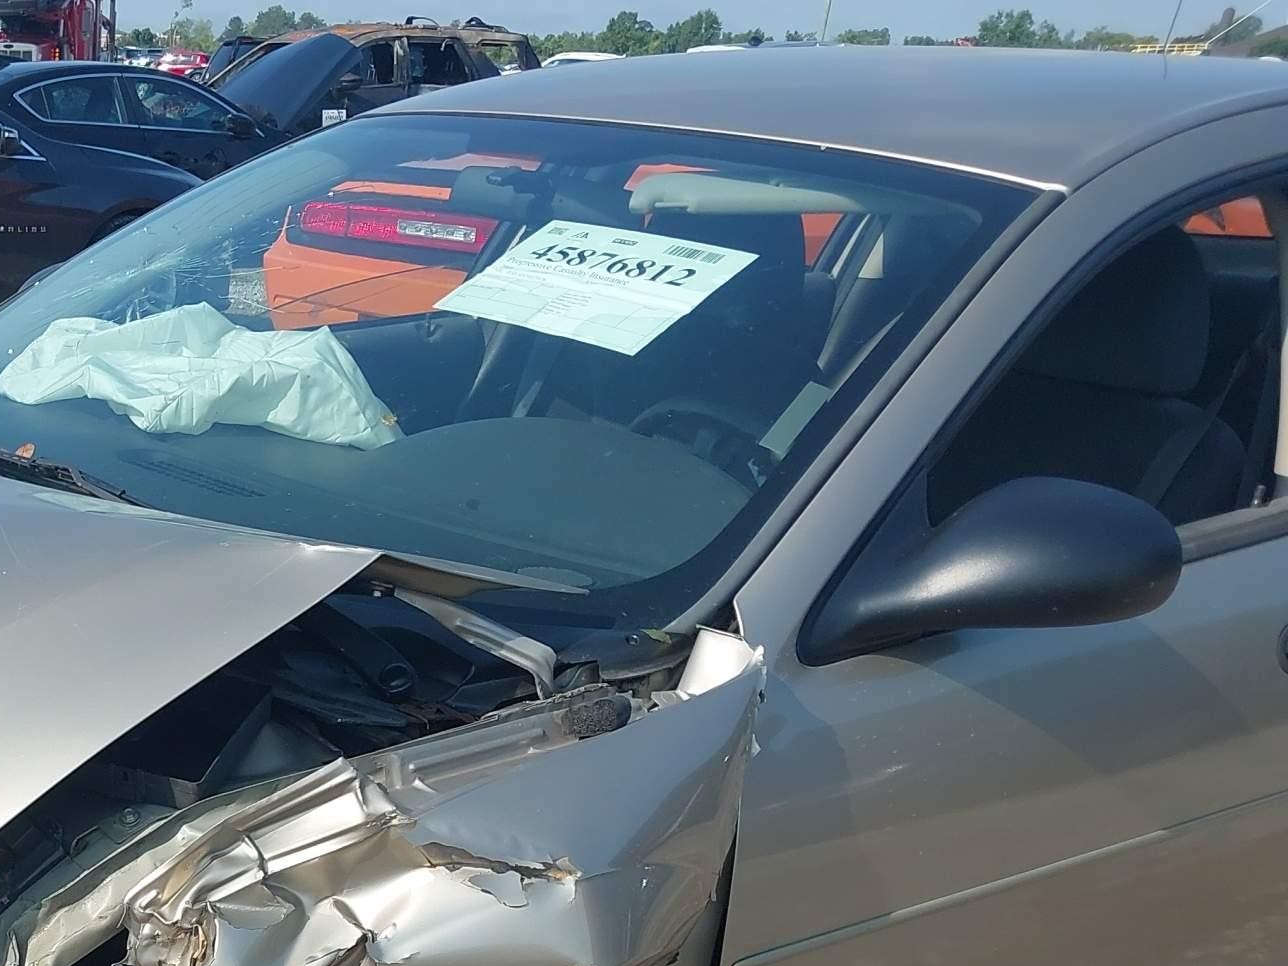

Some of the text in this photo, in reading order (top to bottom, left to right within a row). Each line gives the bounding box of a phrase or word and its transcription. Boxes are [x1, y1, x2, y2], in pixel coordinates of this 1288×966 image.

[506, 256, 553, 270] Progressive
[589, 271, 630, 286] Insurance
[530, 244, 697, 287] 45876812
